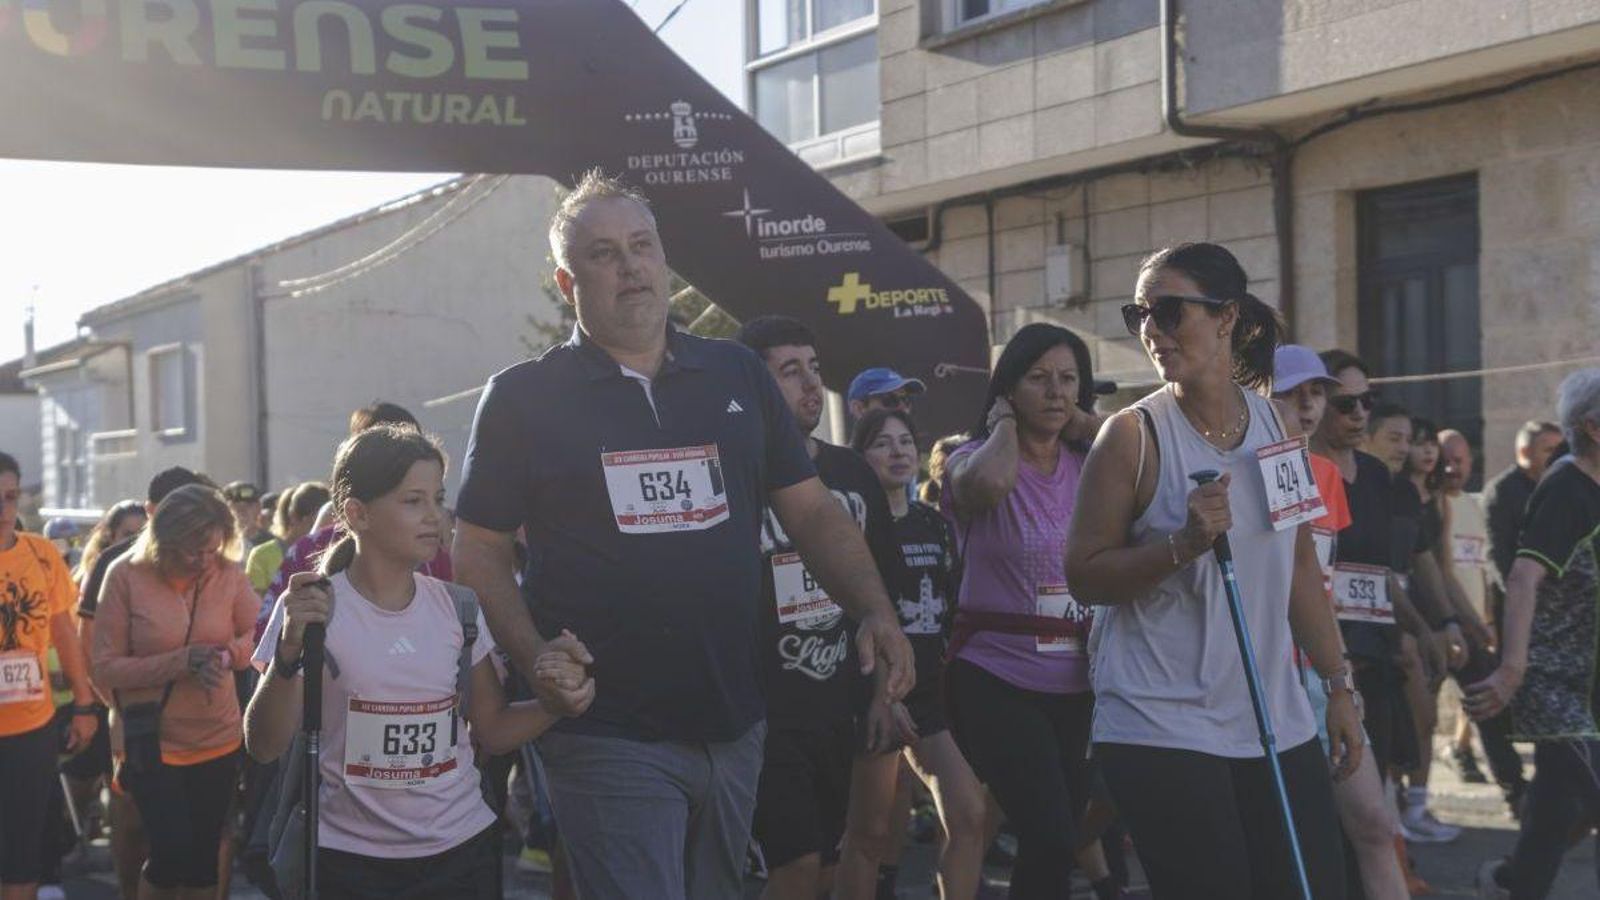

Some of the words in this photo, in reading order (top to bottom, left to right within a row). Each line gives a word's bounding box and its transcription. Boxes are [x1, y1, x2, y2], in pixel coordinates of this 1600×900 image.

[0, 0, 529, 80] URENSE
[322, 89, 526, 126] NATURAL
[627, 149, 744, 169] DEPUTACIÓN
[645, 167, 733, 184] OURENSE
[757, 215, 826, 237] inorde
[760, 240, 814, 258] turismo
[816, 238, 871, 255] Ourense
[895, 306, 912, 318] La
[638, 470, 691, 501] 634
[1275, 460, 1299, 493] 424
[634, 514, 683, 525] Josuma
[1348, 578, 1376, 600] 533
[779, 630, 848, 680] Ligh
[3, 663, 30, 683] 622
[383, 722, 437, 755] 633
[366, 766, 420, 780] Josuma
